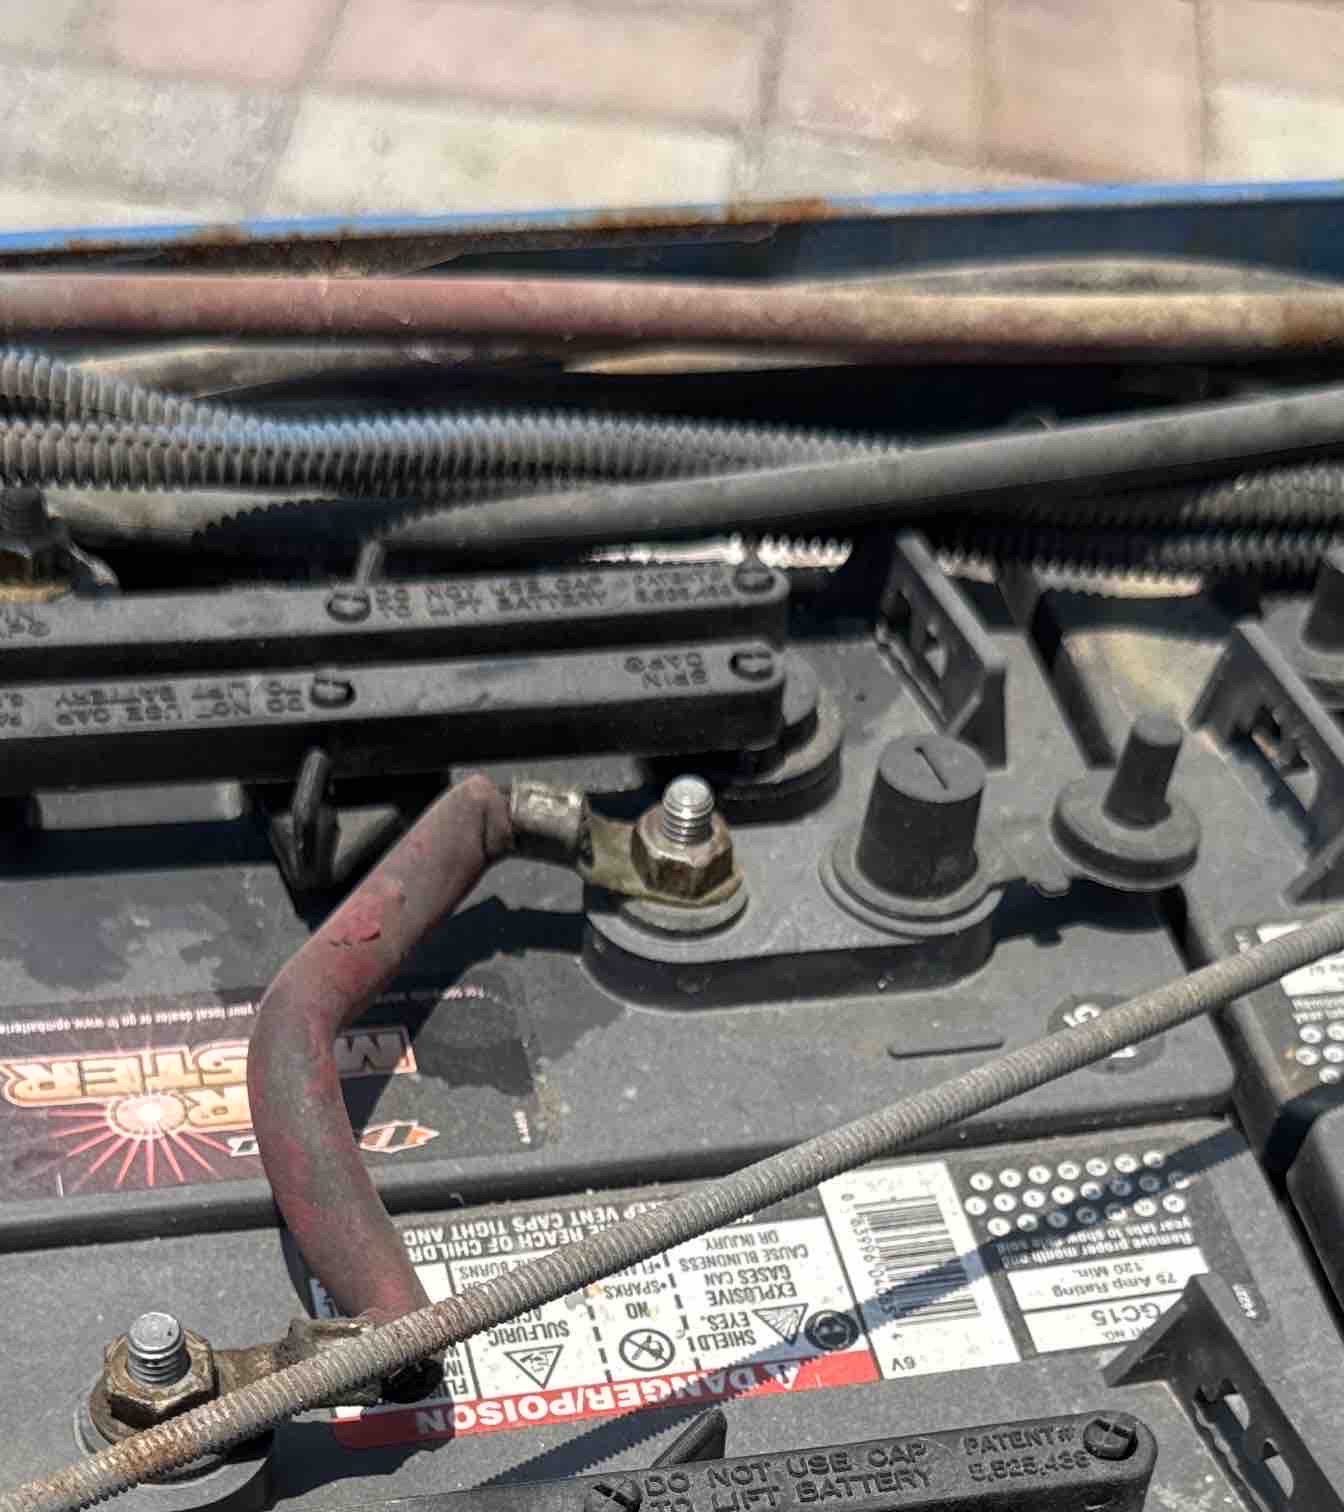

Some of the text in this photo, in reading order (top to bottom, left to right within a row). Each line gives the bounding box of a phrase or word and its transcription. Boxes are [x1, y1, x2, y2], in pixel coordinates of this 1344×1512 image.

[447, 1205, 619, 1239] VENT CAPS TIGHT
[1160, 1216, 1192, 1231] year
[487, 1226, 584, 1251] REACH OF
[758, 1229, 777, 1244] OR
[1080, 1238, 1128, 1254] proper
[1133, 1232, 1192, 1248] Remove
[678, 1243, 807, 1271] CAUSE BLINDNESS
[1115, 1261, 1143, 1273] 120
[703, 1263, 790, 1287] GASES CAN
[1052, 1271, 1176, 1298] 75 Amp Rating
[704, 1281, 797, 1306] EXPLOSIVE
[624, 1300, 650, 1319] NO
[700, 1310, 750, 1330] EYES.
[1090, 1303, 1161, 1326] GC15
[485, 1319, 570, 1346] SULFURIC
[696, 1329, 755, 1351] SHIELD
[890, 1355, 916, 1371] 6V
[414, 1364, 755, 1434] DANGER/POISON
[962, 1424, 1076, 1456] PATENT#
[642, 1440, 928, 1498] DO NOT USE CAP
[794, 1465, 934, 1504] BATTERY
